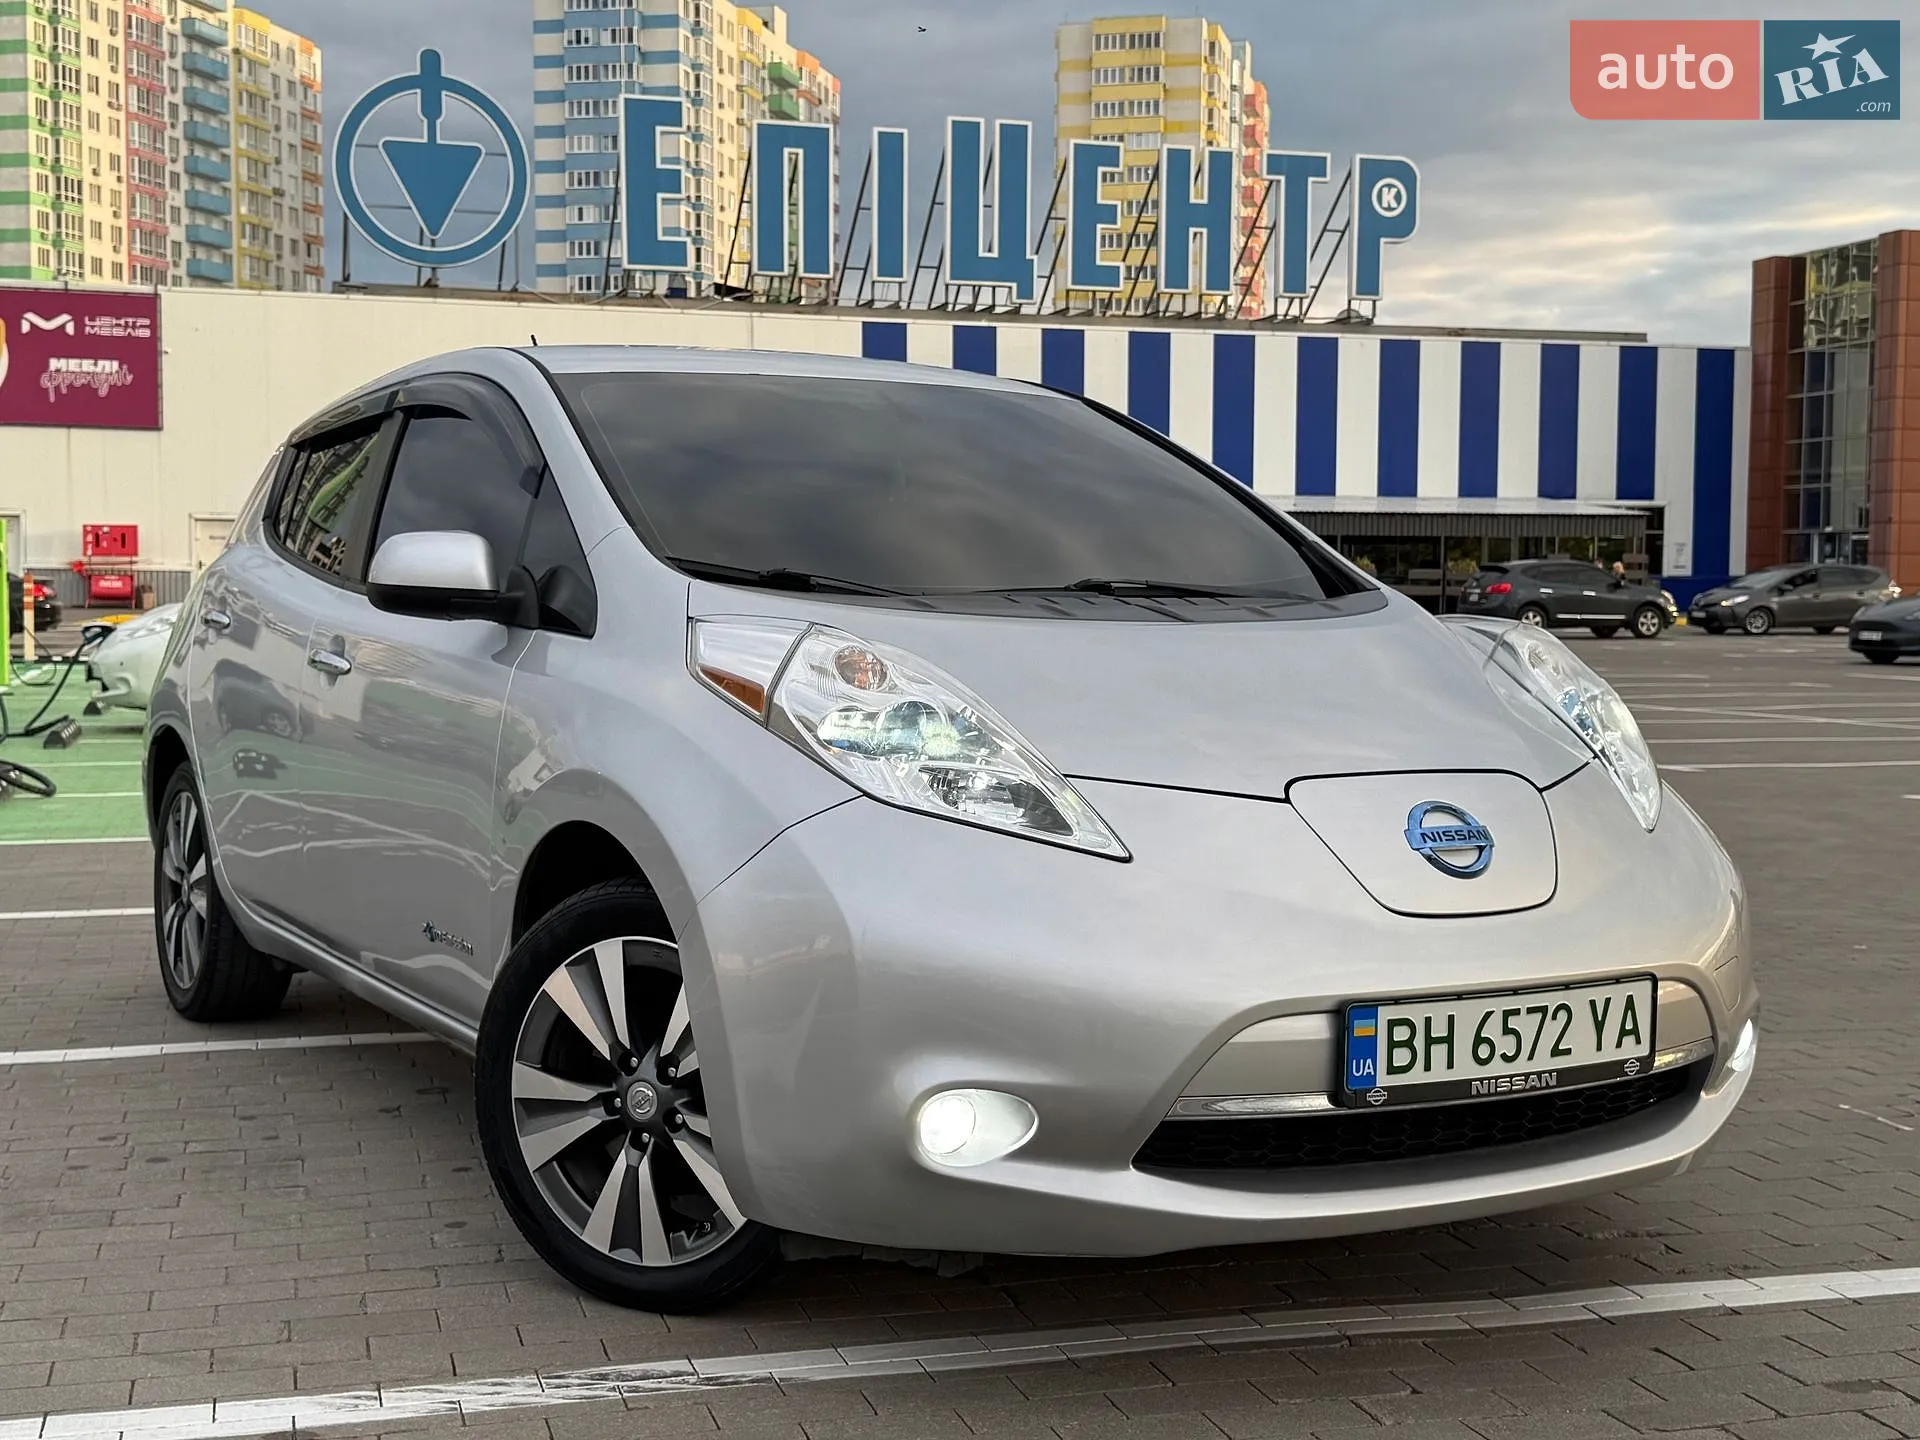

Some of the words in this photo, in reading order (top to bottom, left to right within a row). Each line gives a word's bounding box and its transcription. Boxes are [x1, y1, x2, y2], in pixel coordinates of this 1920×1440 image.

[619, 93, 1420, 305] ЕПІЦЕНТР
[84, 315, 151, 327] ЦЕНТР
[84, 326, 151, 338] МЕБЛІВ
[48, 357, 119, 373] МЕБЛІ
[1420, 829, 1489, 844] NISSAN
[1352, 1058, 1375, 1077] UA
[1386, 1013, 1456, 1076] BH
[1471, 1002, 1574, 1067] 6572
[1588, 993, 1642, 1053] YA
[1471, 1072, 1557, 1096] NISSAN
